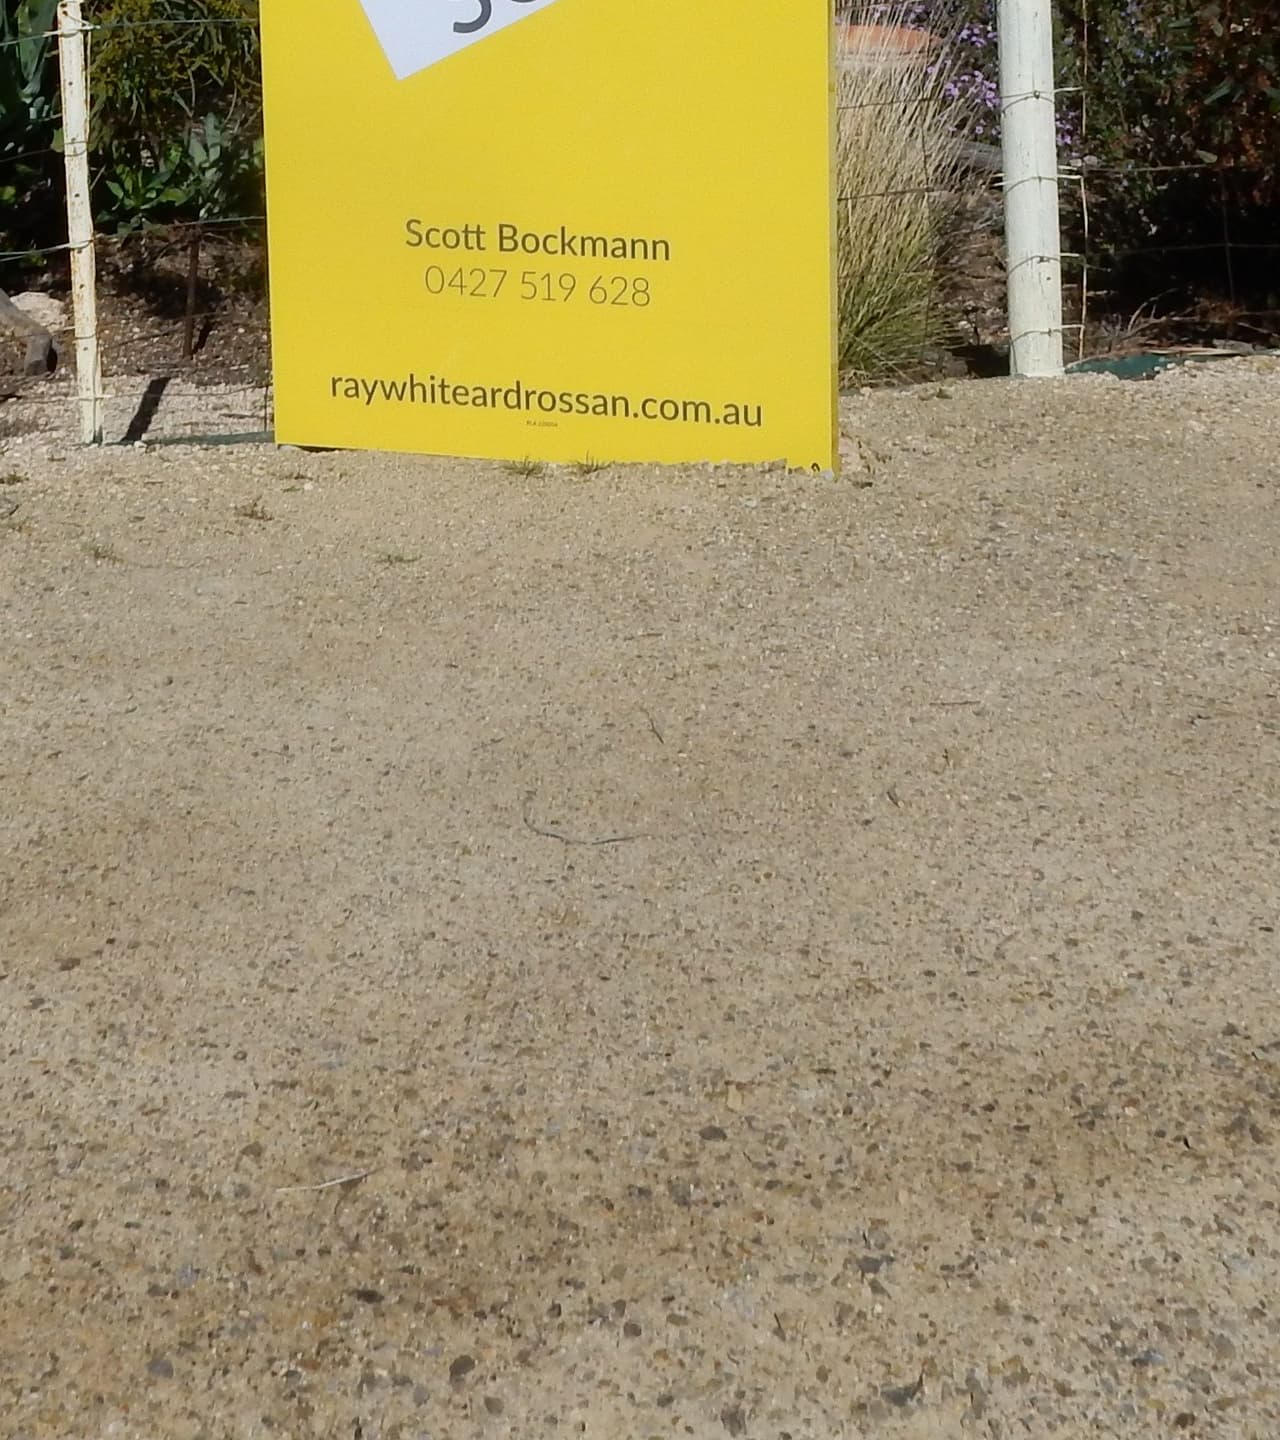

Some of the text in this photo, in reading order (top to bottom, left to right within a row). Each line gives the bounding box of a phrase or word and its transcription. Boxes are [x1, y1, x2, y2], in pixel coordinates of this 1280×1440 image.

[405, 217, 671, 262] Scott Bockmann
[423, 264, 651, 308] 0427 519 628
[330, 373, 763, 427] raywhiteardrossan.com.au
